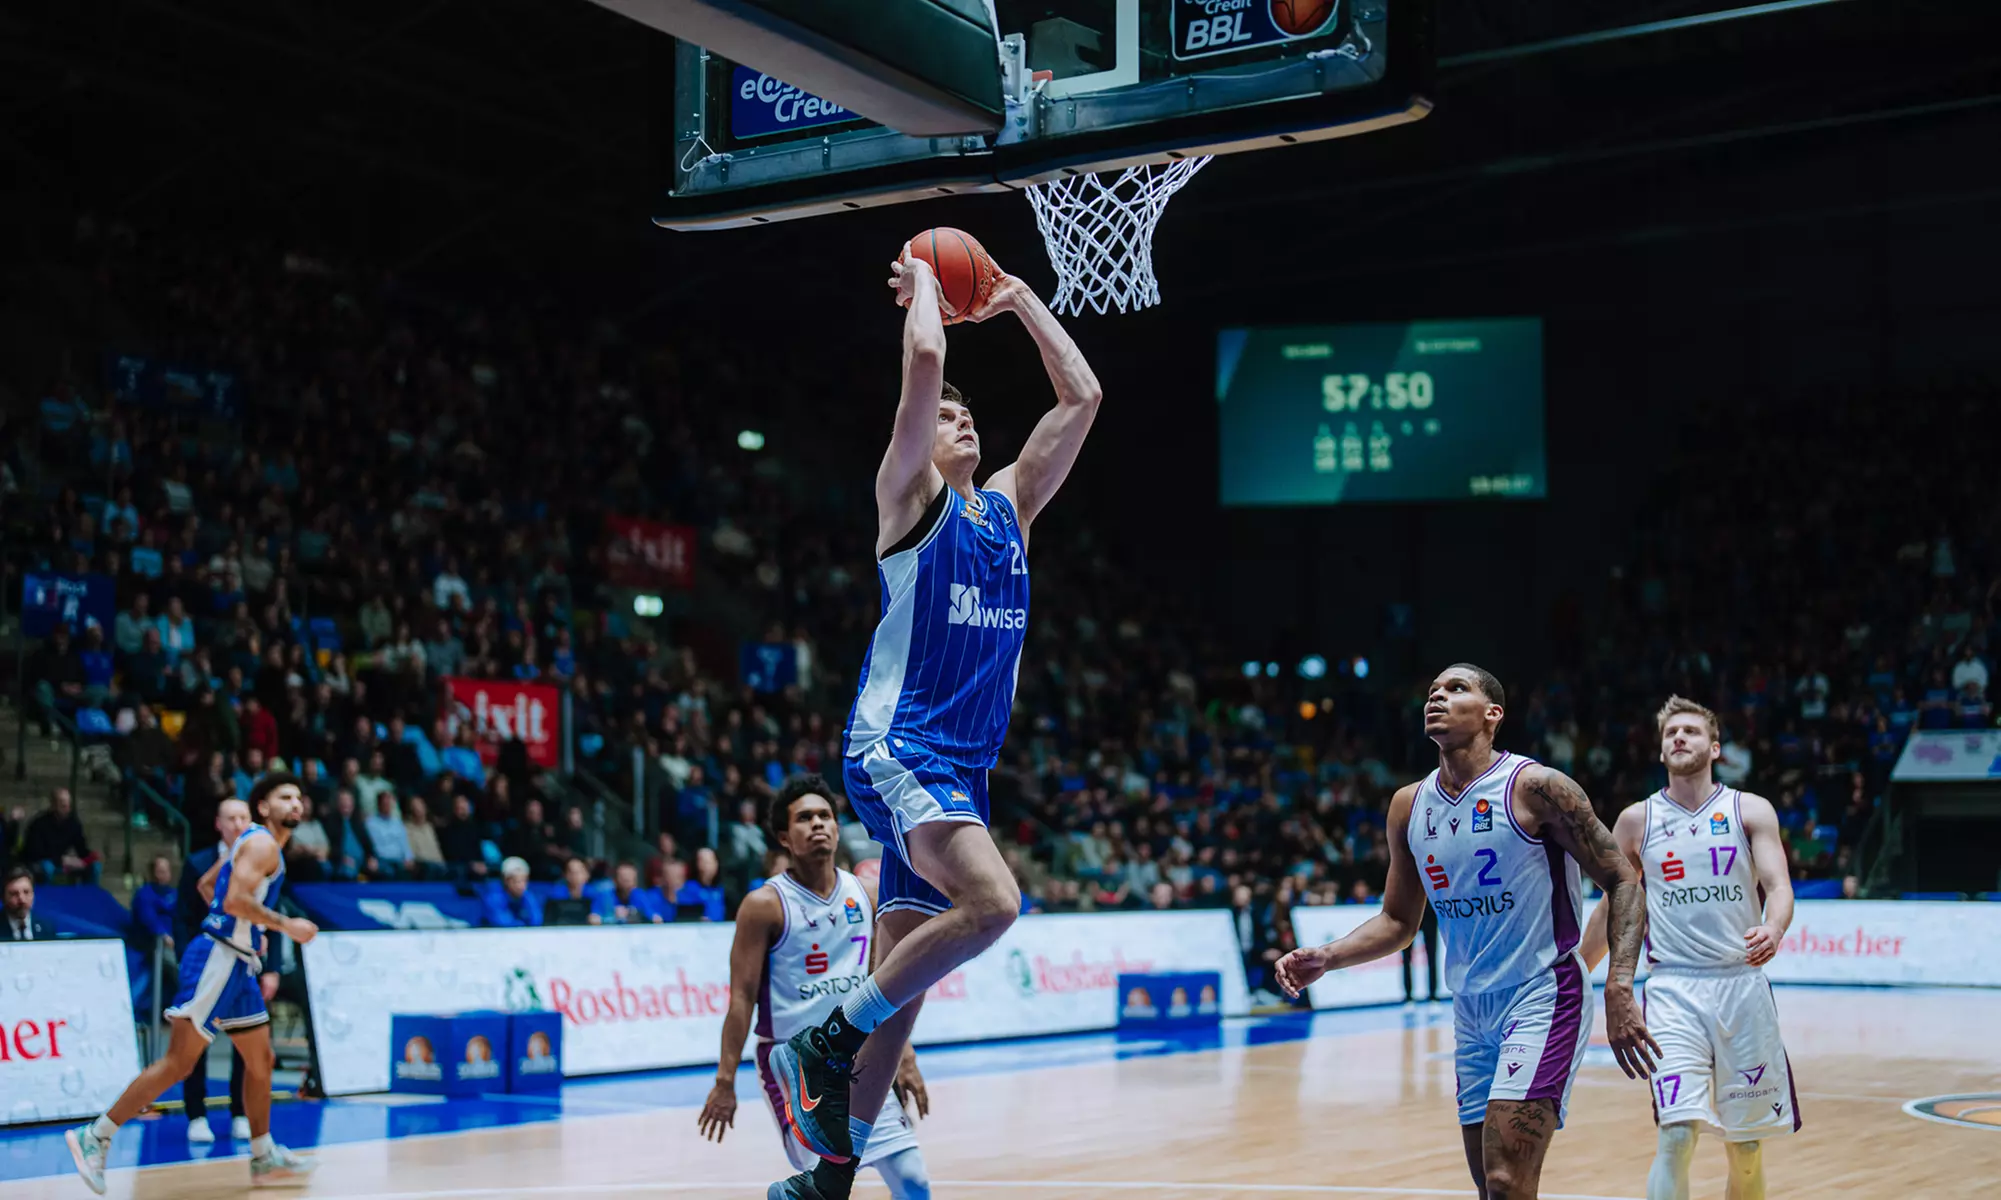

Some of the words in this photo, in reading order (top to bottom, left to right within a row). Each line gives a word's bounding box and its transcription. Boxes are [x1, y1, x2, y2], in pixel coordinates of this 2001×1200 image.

[1185, 12, 1252, 51] BBL
[1323, 372, 1434, 412] 57:50
[1474, 848, 1502, 887] 2
[1708, 846, 1737, 876] 17
[1434, 891, 1515, 919] SRTORIUS
[1662, 884, 1743, 907] SARTORIUS
[851, 936, 867, 965] 7
[1778, 924, 1907, 958] sbacher
[1656, 1074, 1681, 1108] 17
